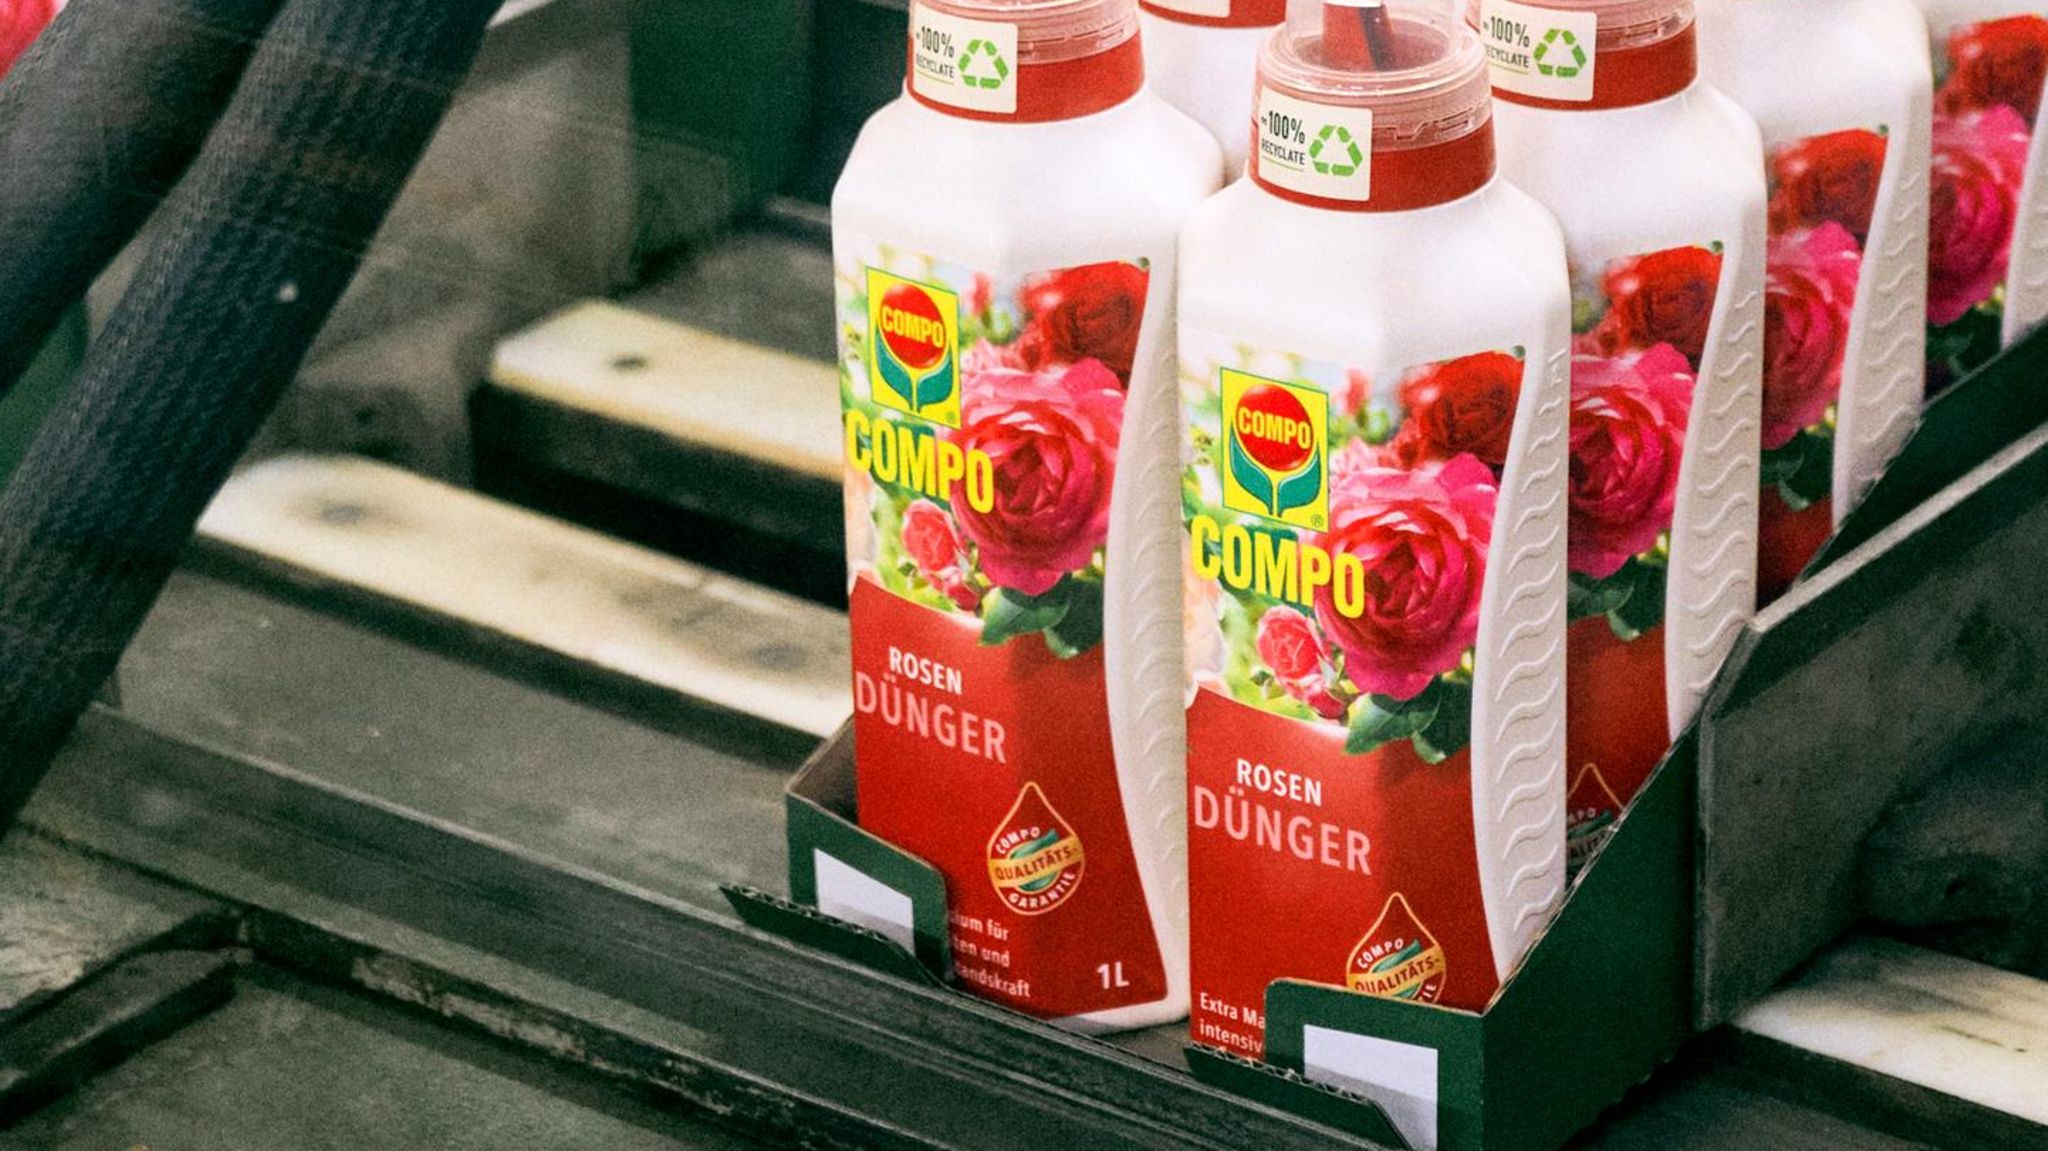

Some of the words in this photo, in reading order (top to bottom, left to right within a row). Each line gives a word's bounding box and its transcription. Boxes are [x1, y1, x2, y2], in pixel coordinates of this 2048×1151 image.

[921, 26, 955, 58] 100%
[1491, 16, 1530, 48] 100%
[1485, 45, 1530, 69] ECYCLATE
[1269, 110, 1306, 144] 100%
[1262, 138, 1305, 165] RECYCLATE
[880, 305, 944, 348] COMPO
[1237, 406, 1311, 449] COMPO
[846, 409, 994, 514] COMPO
[1190, 514, 1365, 619] COMPO
[888, 646, 963, 695] ROSEN
[855, 671, 1006, 764] DÜNGER
[1236, 758, 1322, 807] ROSEN
[995, 826, 1041, 855] COMPO
[1194, 785, 1372, 875] DÜNGER
[1008, 872, 1076, 909] GARANTIE
[986, 918, 1008, 941] für
[981, 947, 1010, 967] und
[1357, 938, 1404, 969] COMPO
[1200, 992, 1238, 1020] Extra
[1242, 1006, 1266, 1029] Ma
[1200, 1018, 1263, 1053] intensiv
